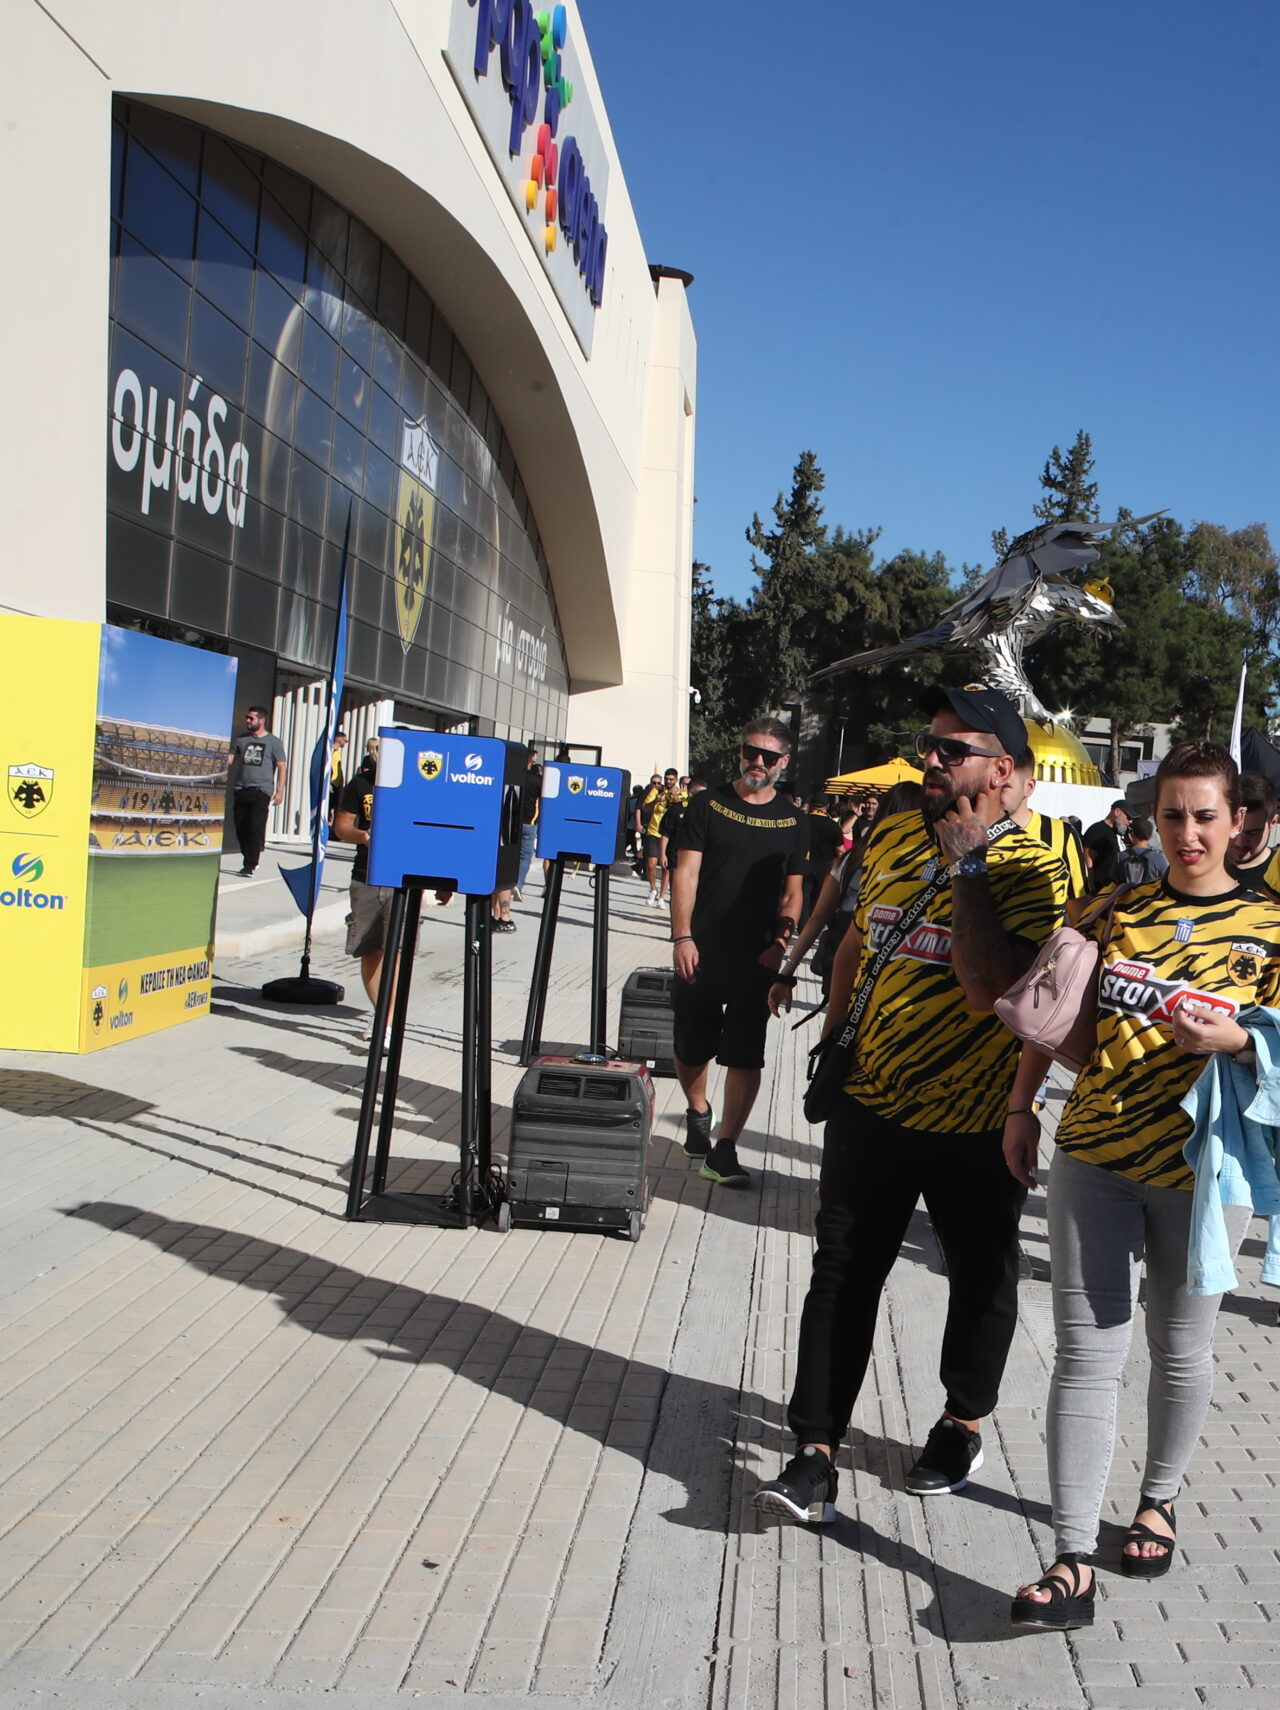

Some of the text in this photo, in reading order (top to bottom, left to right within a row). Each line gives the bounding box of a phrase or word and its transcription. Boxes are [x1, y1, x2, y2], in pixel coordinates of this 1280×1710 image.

[112, 368, 250, 528] ομάδα
[450, 772, 493, 786] volton
[132, 791, 202, 812] 19 24
[587, 789, 614, 798] volton
[986, 819, 1017, 840] Kapp
[0, 888, 64, 910] olton
[1114, 963, 1146, 979] pame
[110, 1011, 133, 1030] volton
